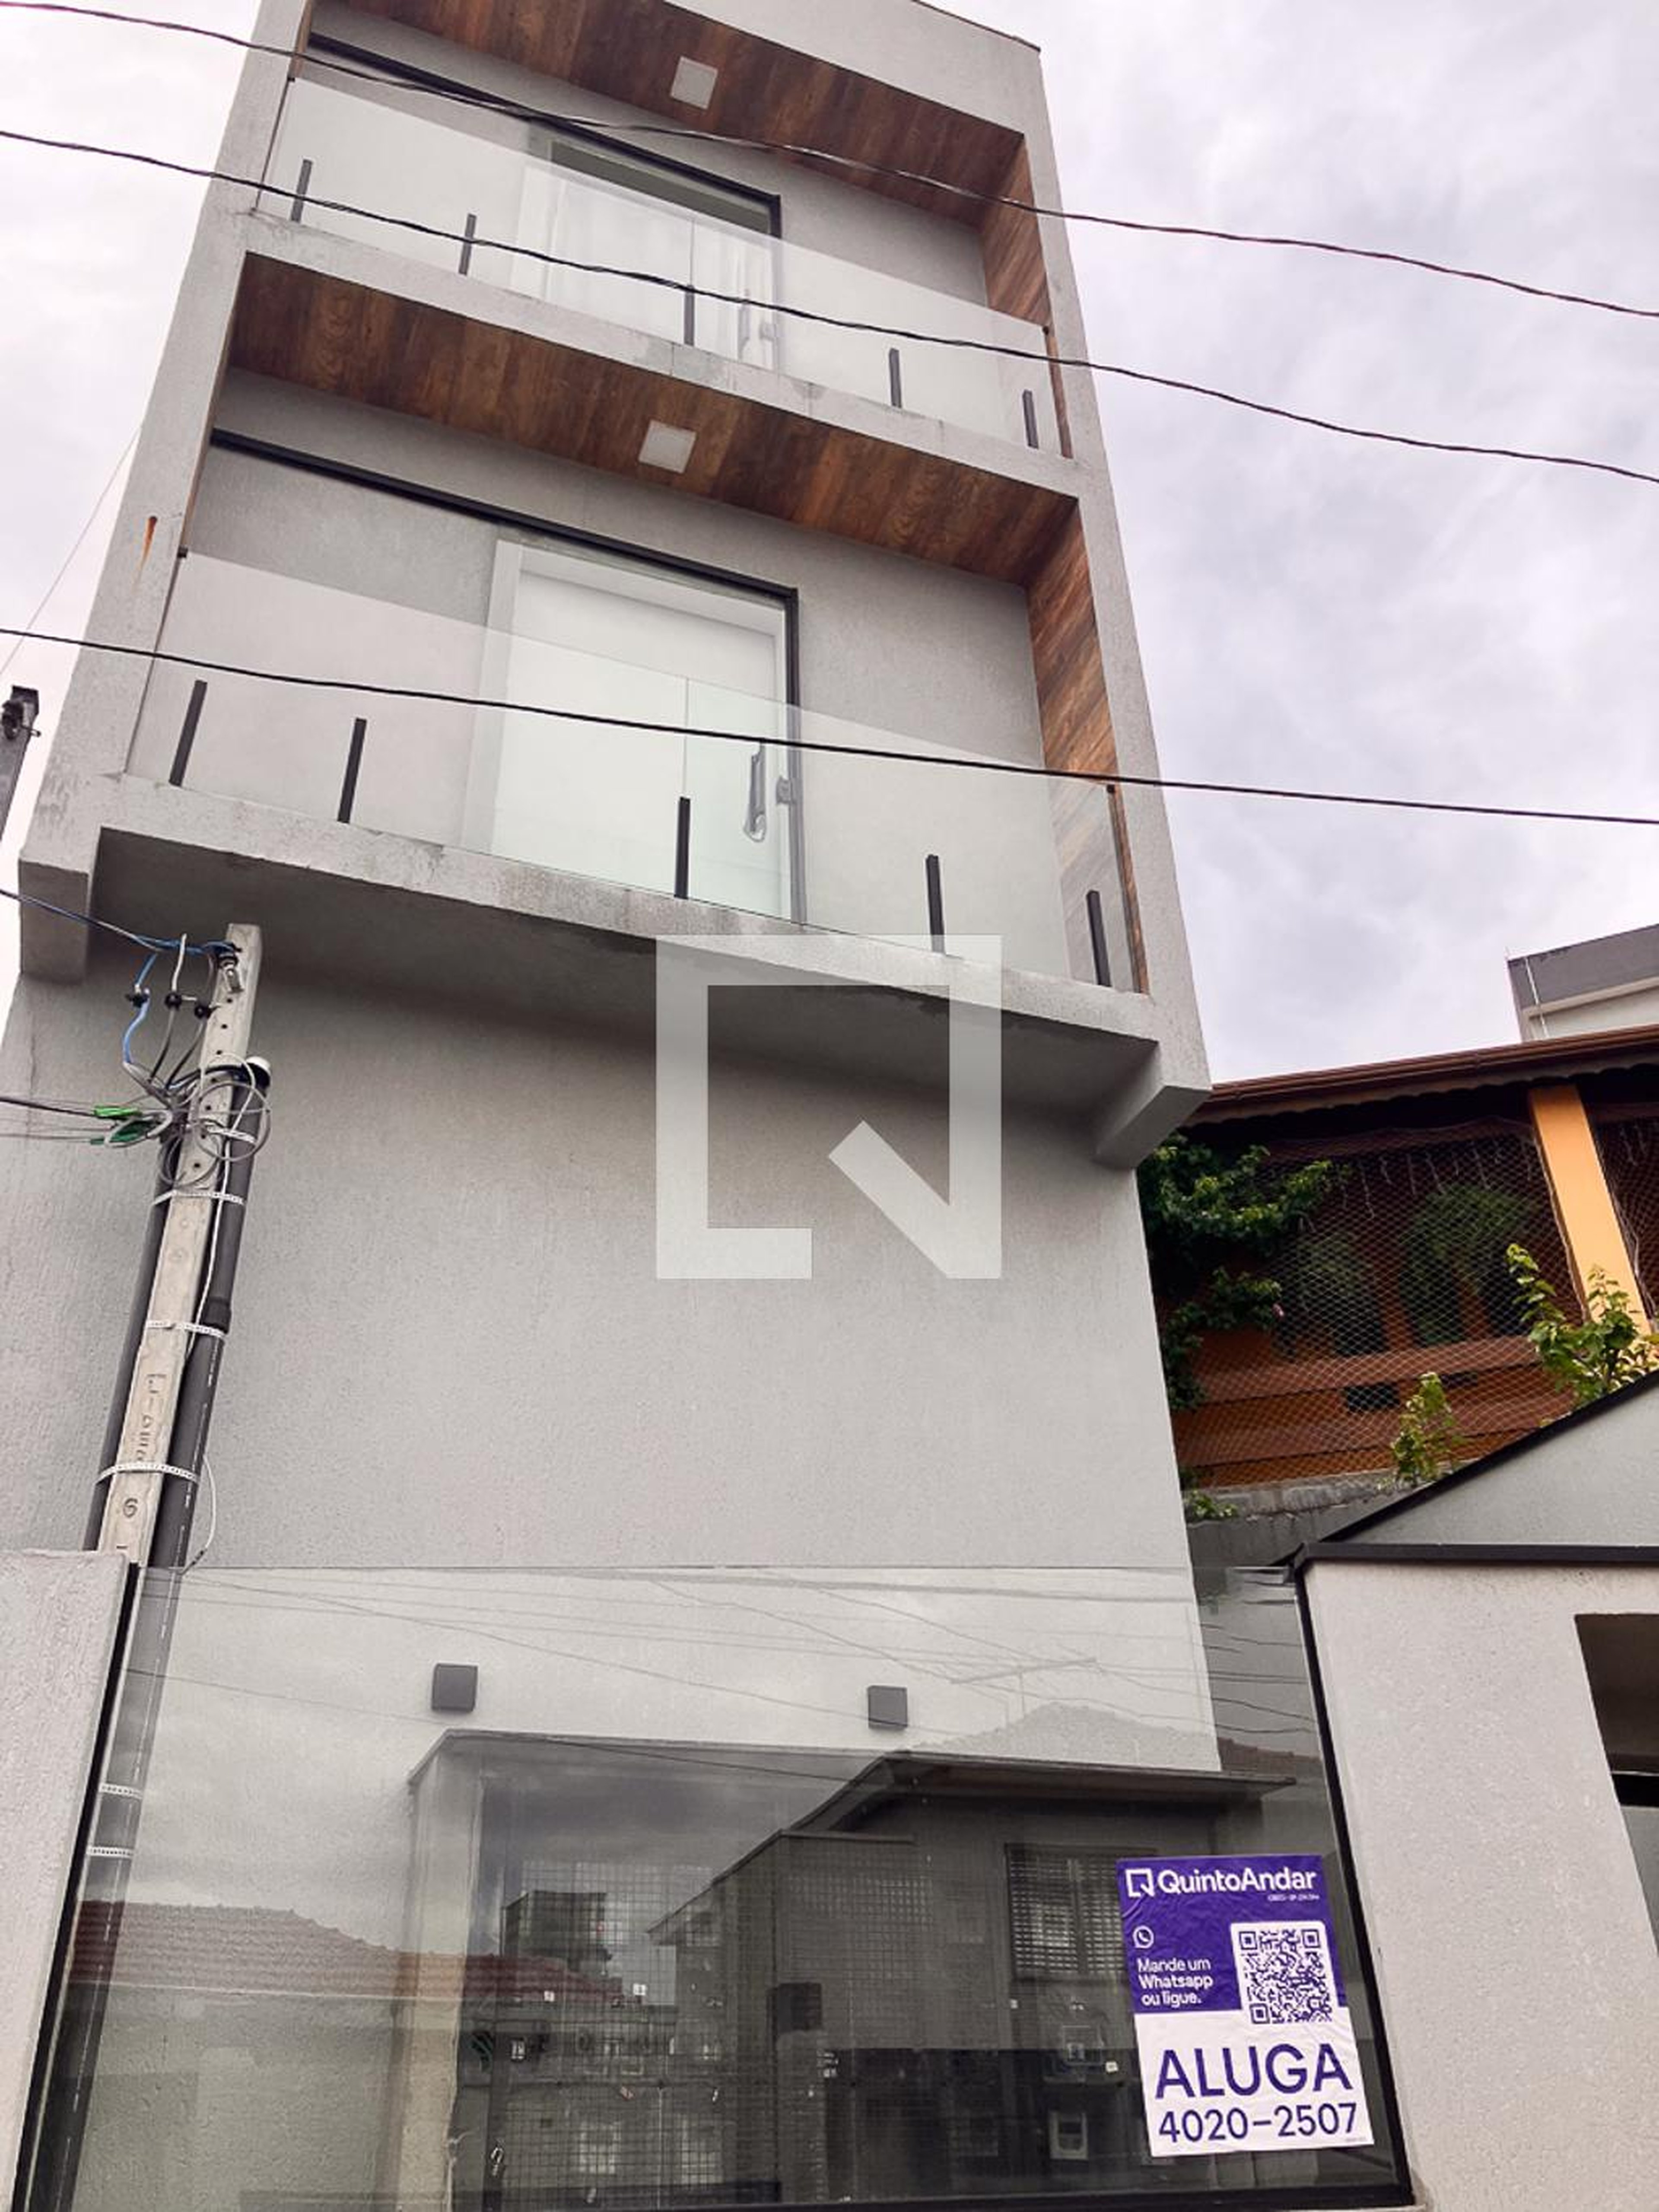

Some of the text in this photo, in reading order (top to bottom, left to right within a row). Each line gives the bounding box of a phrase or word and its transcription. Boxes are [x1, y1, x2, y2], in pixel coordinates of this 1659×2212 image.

[1157, 1866, 1317, 1894] QuintoAndar
[1137, 1957, 1211, 1972] Mande um
[1138, 1973, 1214, 1990] Whatsapp
[1141, 1990, 1202, 2008] ou ligue.
[1155, 2043, 1353, 2099] ALUGA
[1159, 2103, 1357, 2143] 4020-2507
